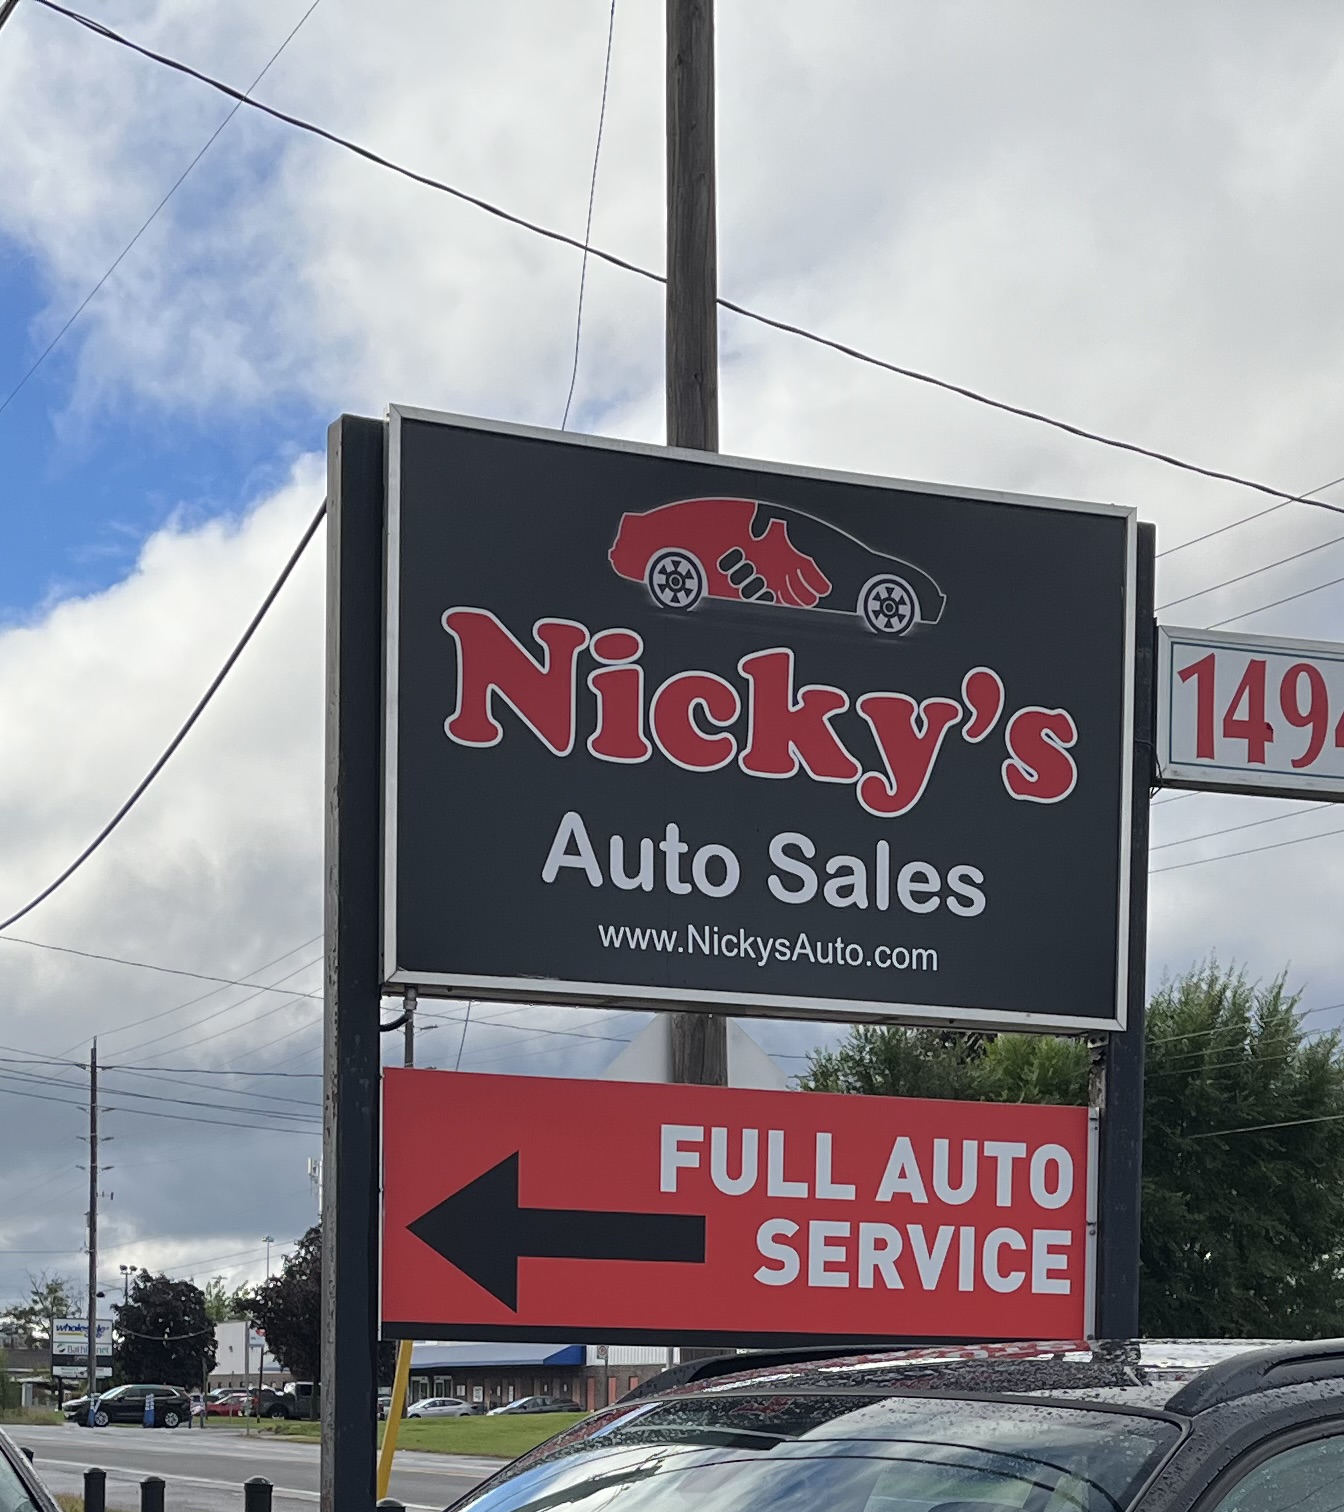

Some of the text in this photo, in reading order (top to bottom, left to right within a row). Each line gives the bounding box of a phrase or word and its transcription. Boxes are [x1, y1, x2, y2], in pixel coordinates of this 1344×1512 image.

[441, 606, 1079, 818] Nicky's
[541, 811, 987, 918] Auto Sales
[598, 923, 939, 972] www.NickysAuto.com
[659, 1123, 1074, 1210] FULL AUTO
[753, 1217, 1072, 1295] SERVICE
